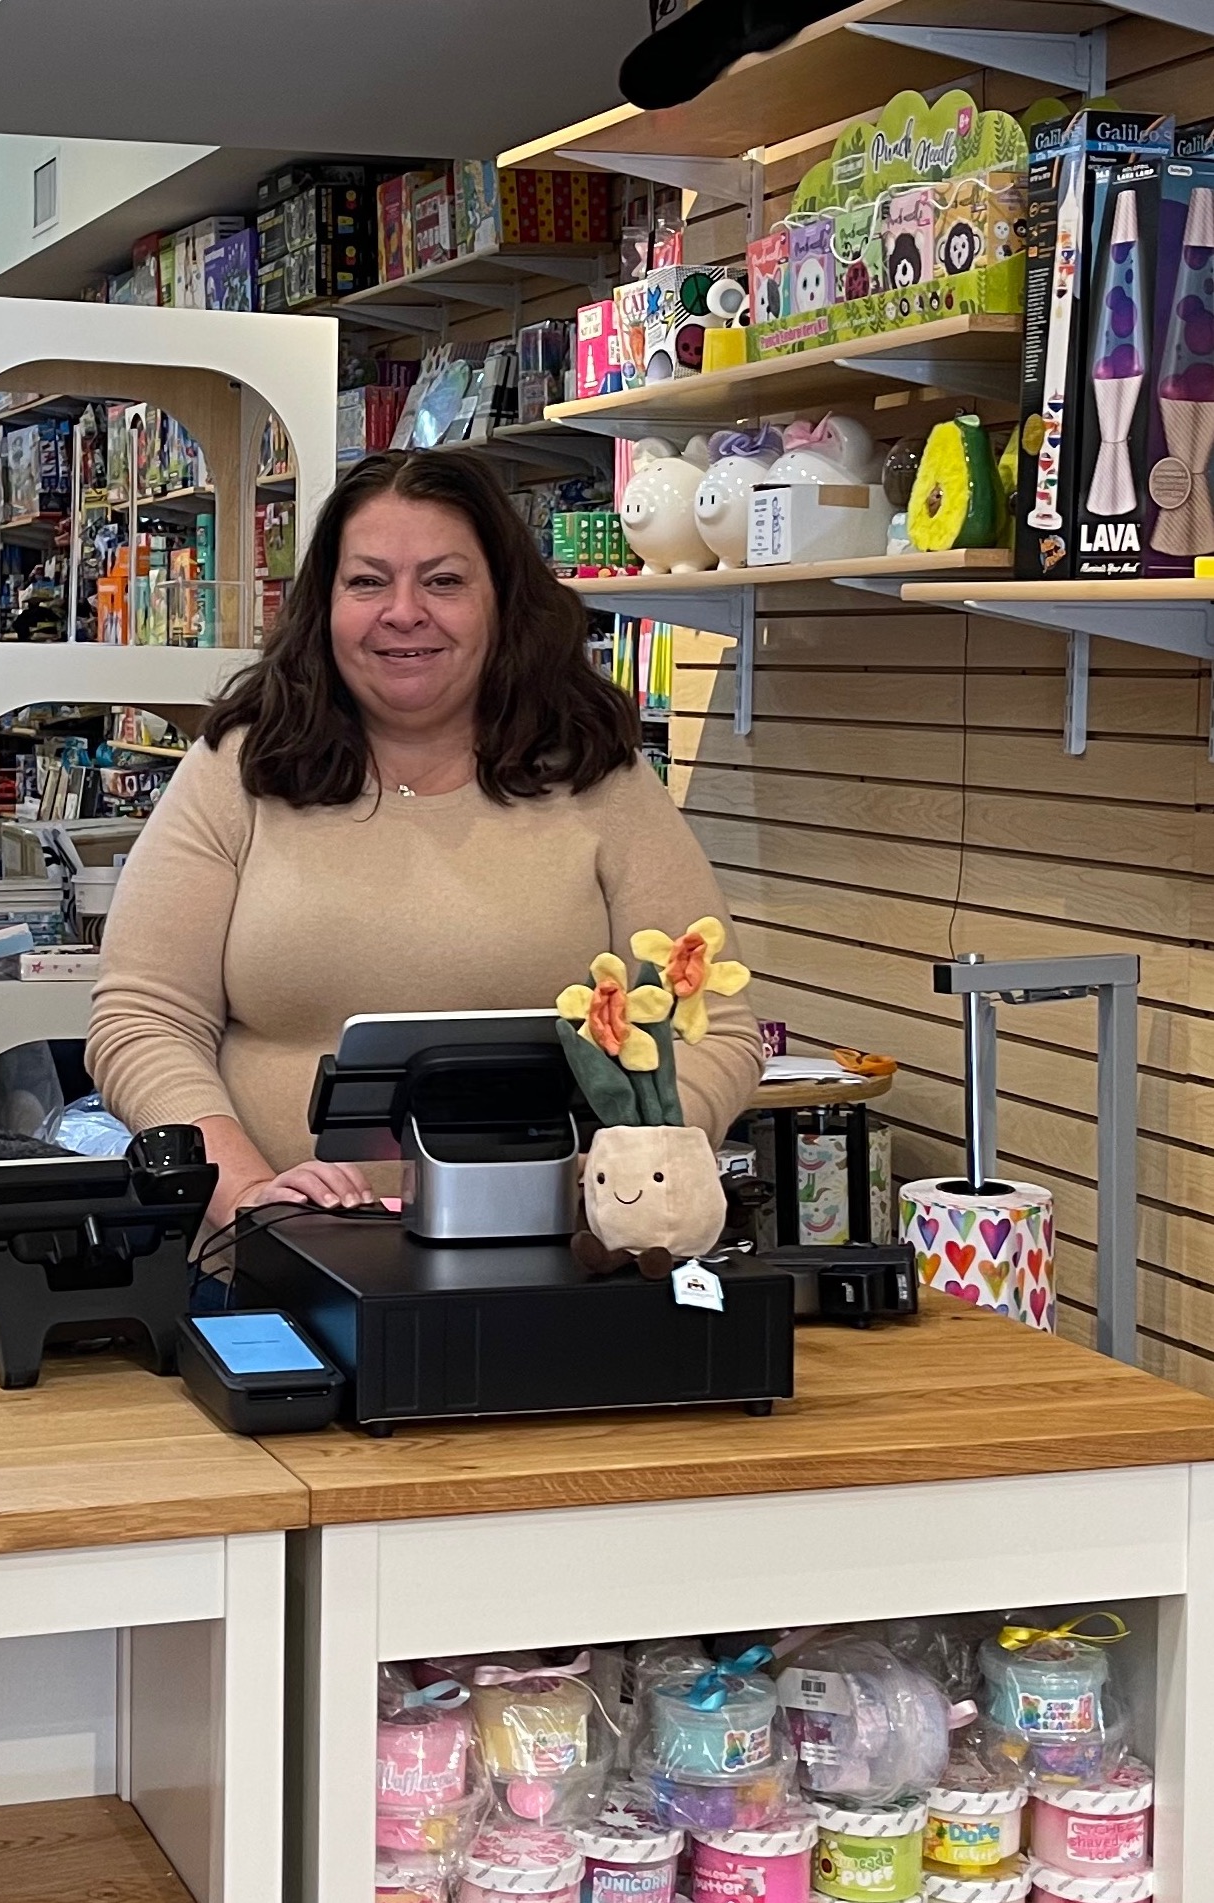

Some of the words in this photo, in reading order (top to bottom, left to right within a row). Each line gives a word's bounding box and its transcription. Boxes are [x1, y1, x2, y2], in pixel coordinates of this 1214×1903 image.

[871, 118, 913, 172] Punch
[913, 129, 956, 172] Needle
[1080, 523, 1140, 552] LAVA
[601, 1875, 668, 1892] UNICORN
[840, 1866, 894, 1887] PUFF
